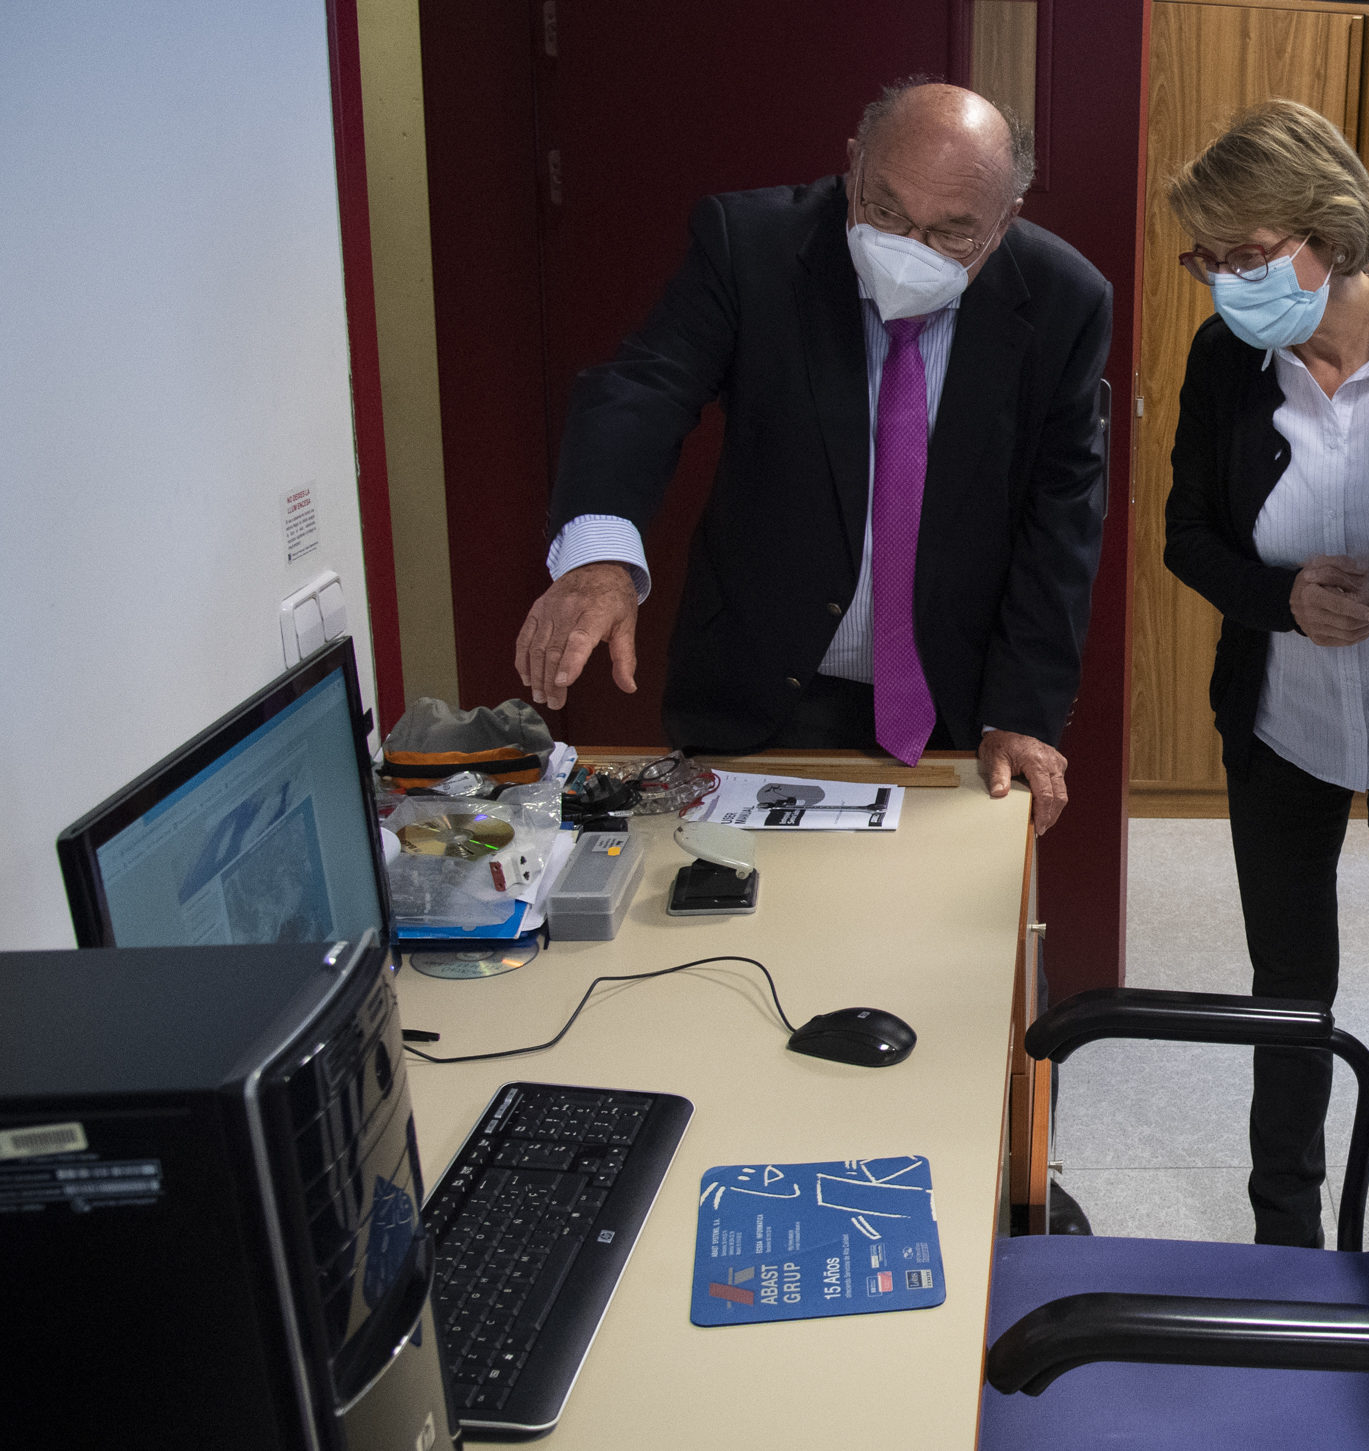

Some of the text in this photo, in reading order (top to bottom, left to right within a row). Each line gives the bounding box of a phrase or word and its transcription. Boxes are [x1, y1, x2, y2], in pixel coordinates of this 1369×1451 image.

[760, 1264, 779, 1306] ABAST
[783, 1262, 802, 1304] GRUP
[824, 1257, 841, 1300] 15 Años
